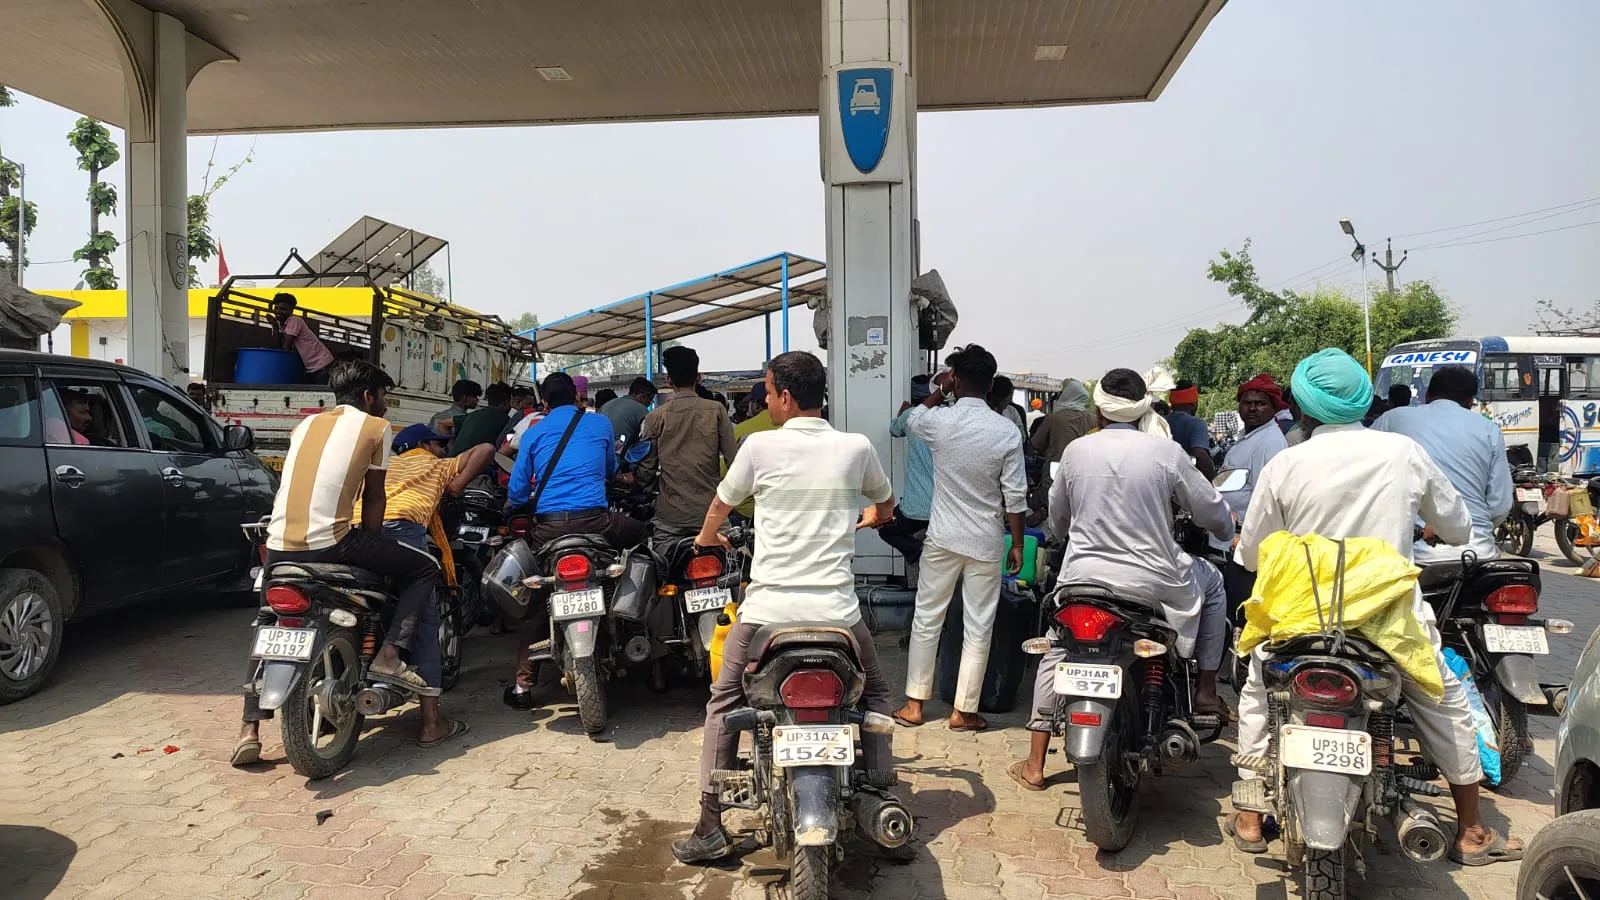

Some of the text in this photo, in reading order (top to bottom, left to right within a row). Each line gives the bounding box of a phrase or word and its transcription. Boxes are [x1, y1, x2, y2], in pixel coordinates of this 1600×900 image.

[1391, 351, 1471, 364] GANESH
[562, 590, 597, 604] UP31C
[690, 596, 728, 611] 5787
[563, 601, 598, 615] B7480
[268, 630, 308, 644] UP31B
[264, 643, 305, 656] Z0197
[1066, 668, 1109, 679] UP31AR
[786, 732, 840, 742] UP31AZ
[779, 746, 849, 761] 1543
[1312, 738, 1365, 755] UP31BC
[1312, 752, 1365, 769] 2298
